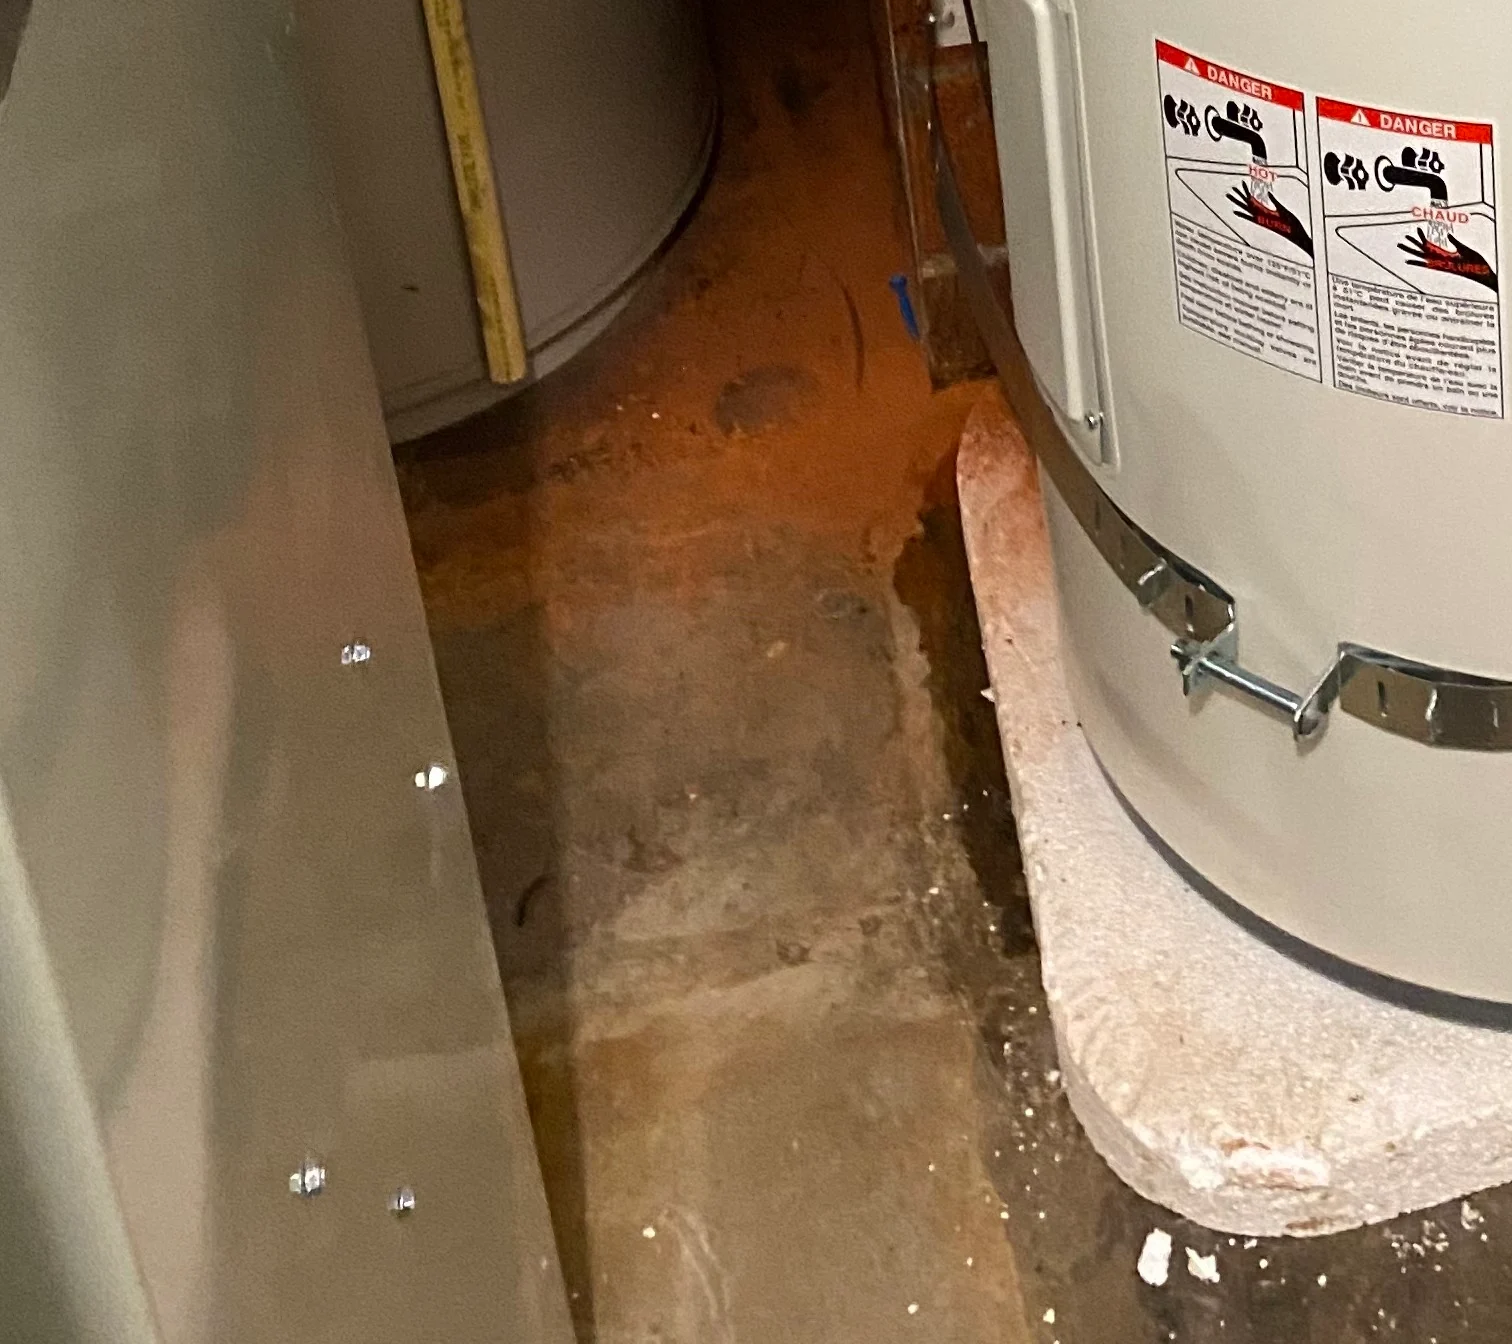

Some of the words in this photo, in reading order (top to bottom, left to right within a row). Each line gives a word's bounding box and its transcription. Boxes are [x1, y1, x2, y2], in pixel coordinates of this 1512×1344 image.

[1207, 64, 1272, 101] DANGER
[1380, 113, 1457, 139] DANGER
[1249, 165, 1277, 182] HOT
[1255, 215, 1292, 234] BURN
[1411, 206, 1470, 224] CHAUD
